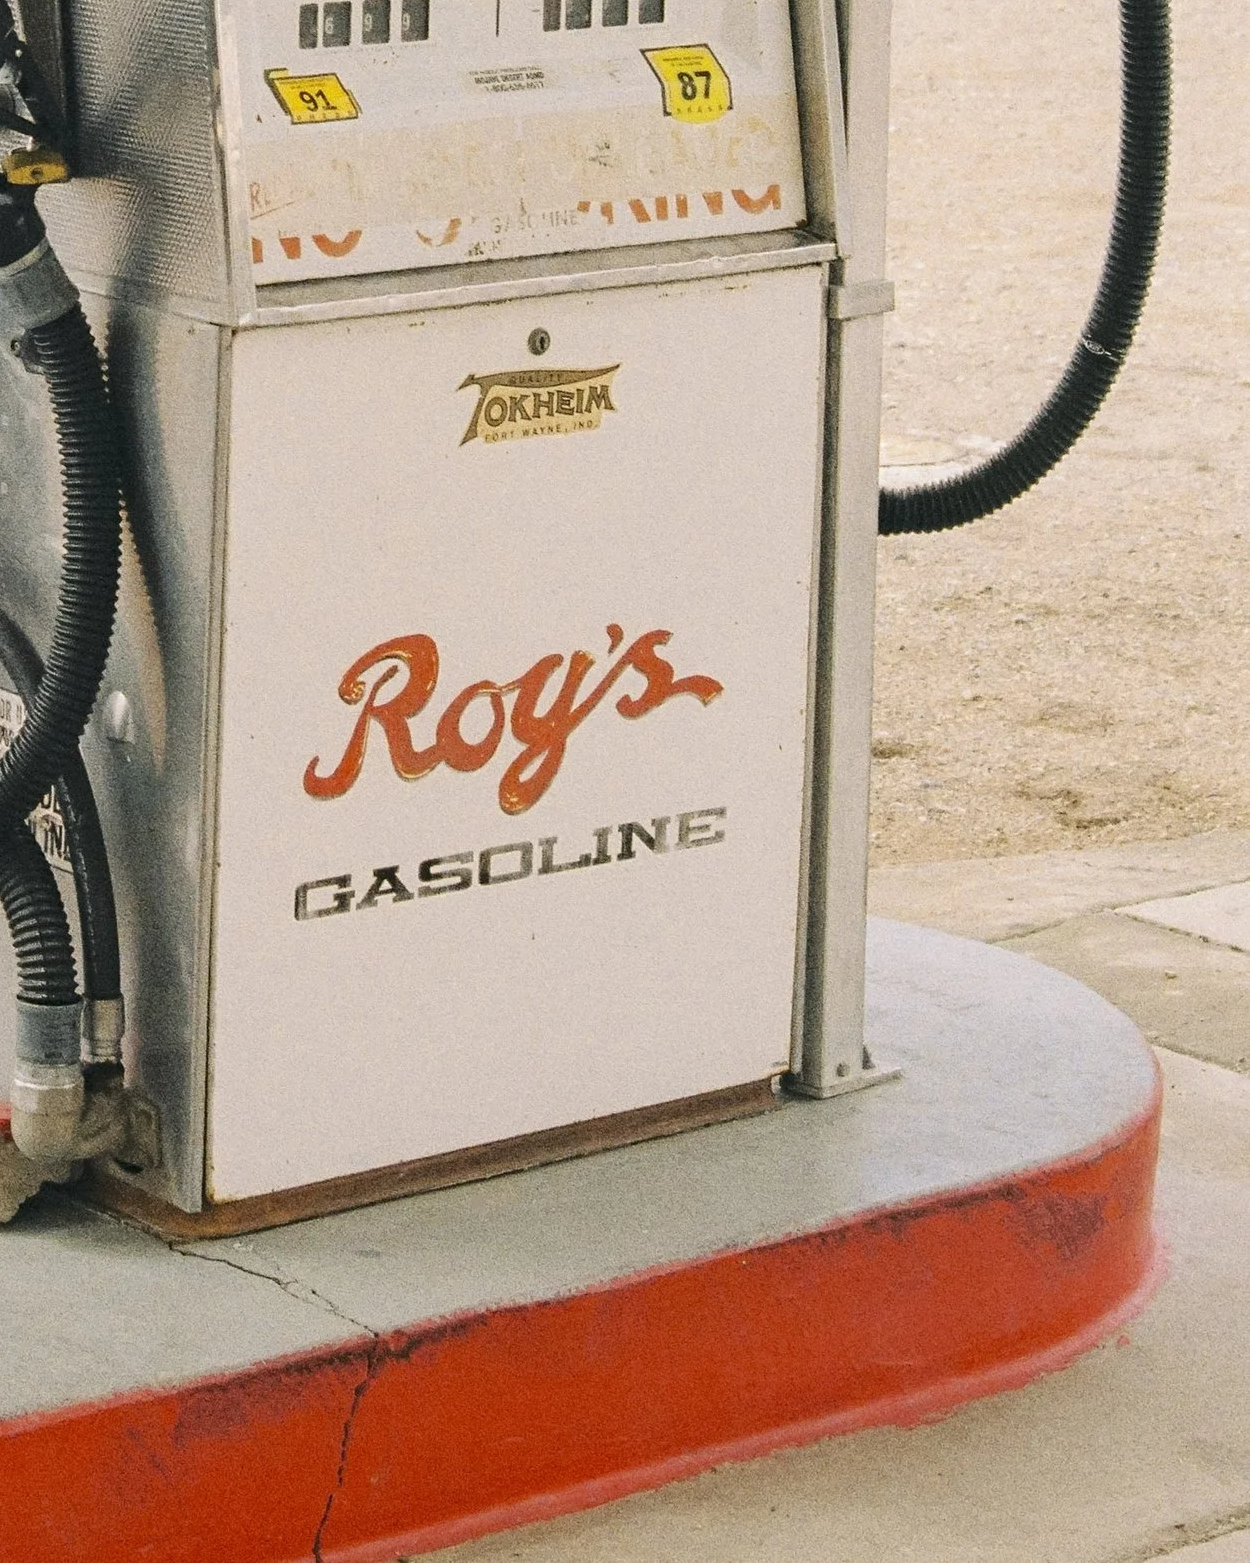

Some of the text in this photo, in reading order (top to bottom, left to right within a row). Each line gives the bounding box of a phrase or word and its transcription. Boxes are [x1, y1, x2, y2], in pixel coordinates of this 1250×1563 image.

[299, 89, 337, 112] 91
[677, 71, 711, 100] 87
[456, 363, 621, 447] TOKHEIM
[484, 432, 515, 443] FORT
[522, 425, 567, 437] WAYNE,
[302, 622, 725, 817] Roy's
[293, 806, 728, 922] GASOLINE
